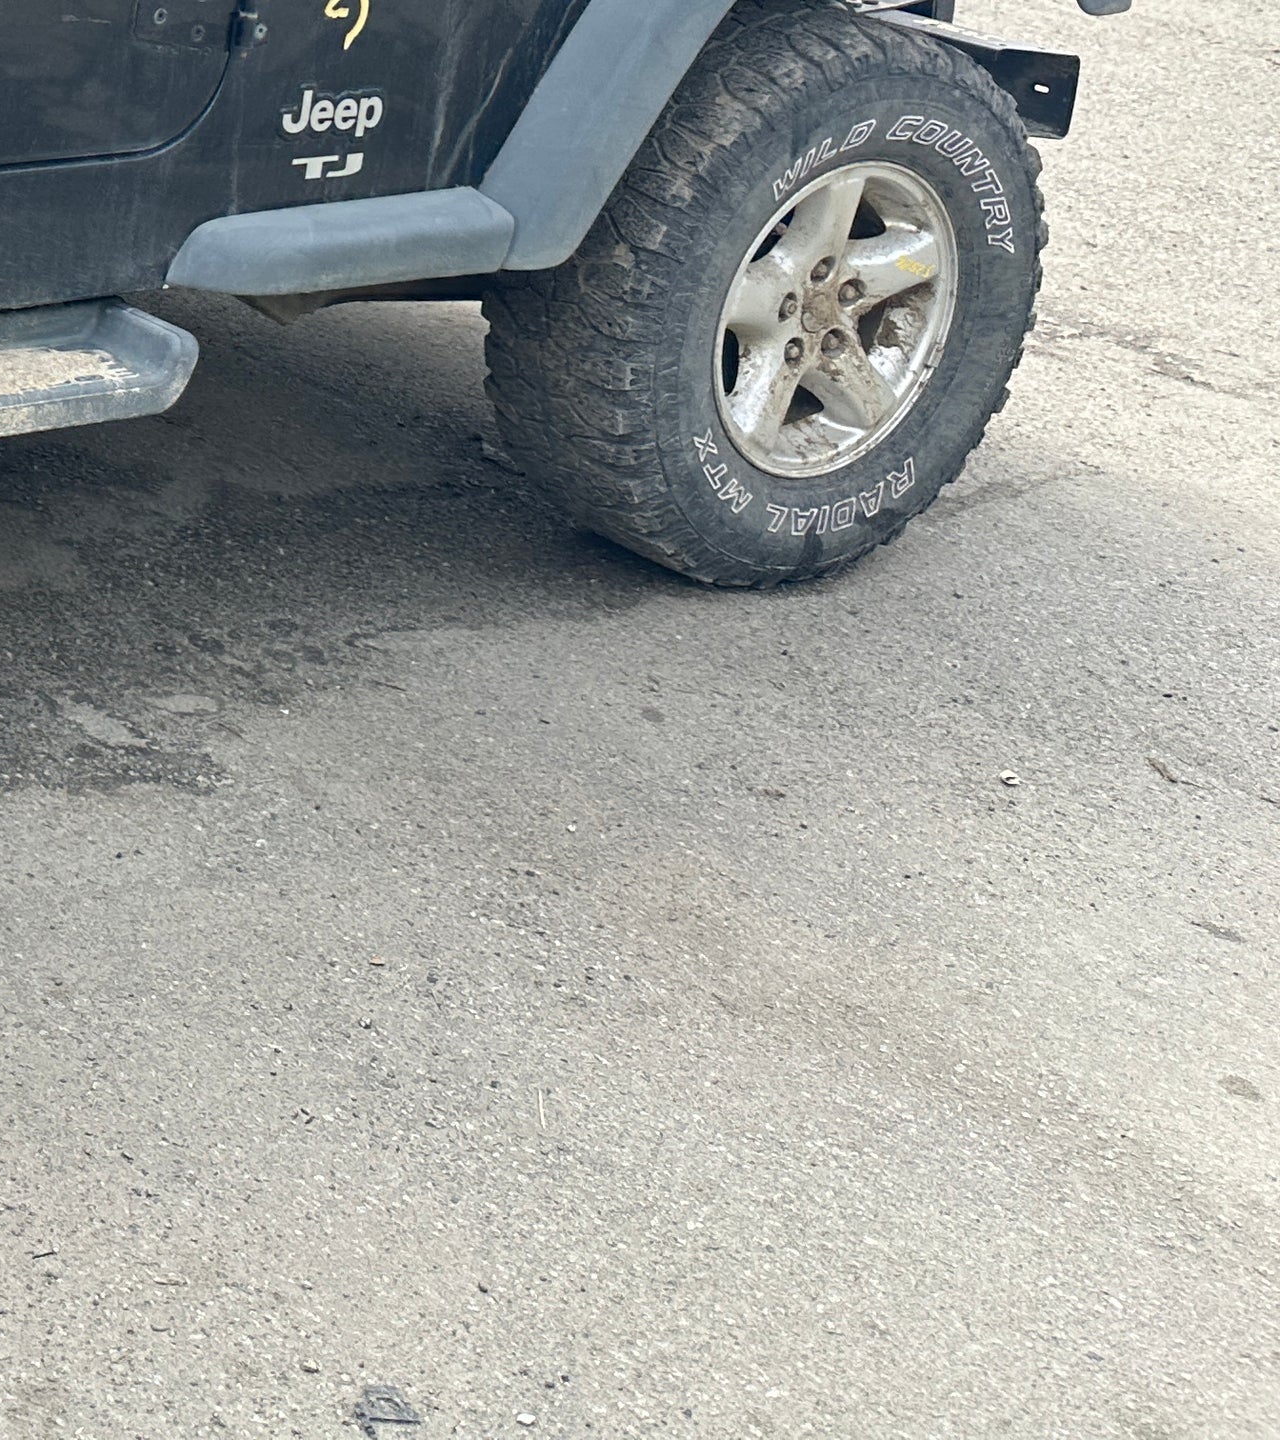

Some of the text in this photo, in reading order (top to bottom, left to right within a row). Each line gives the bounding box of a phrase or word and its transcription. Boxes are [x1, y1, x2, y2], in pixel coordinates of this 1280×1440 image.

[282, 89, 384, 138] Jeep
[291, 152, 364, 180] TJ
[772, 115, 1015, 254] WILD COUNTRY
[692, 427, 916, 537] RADIAL MTX
